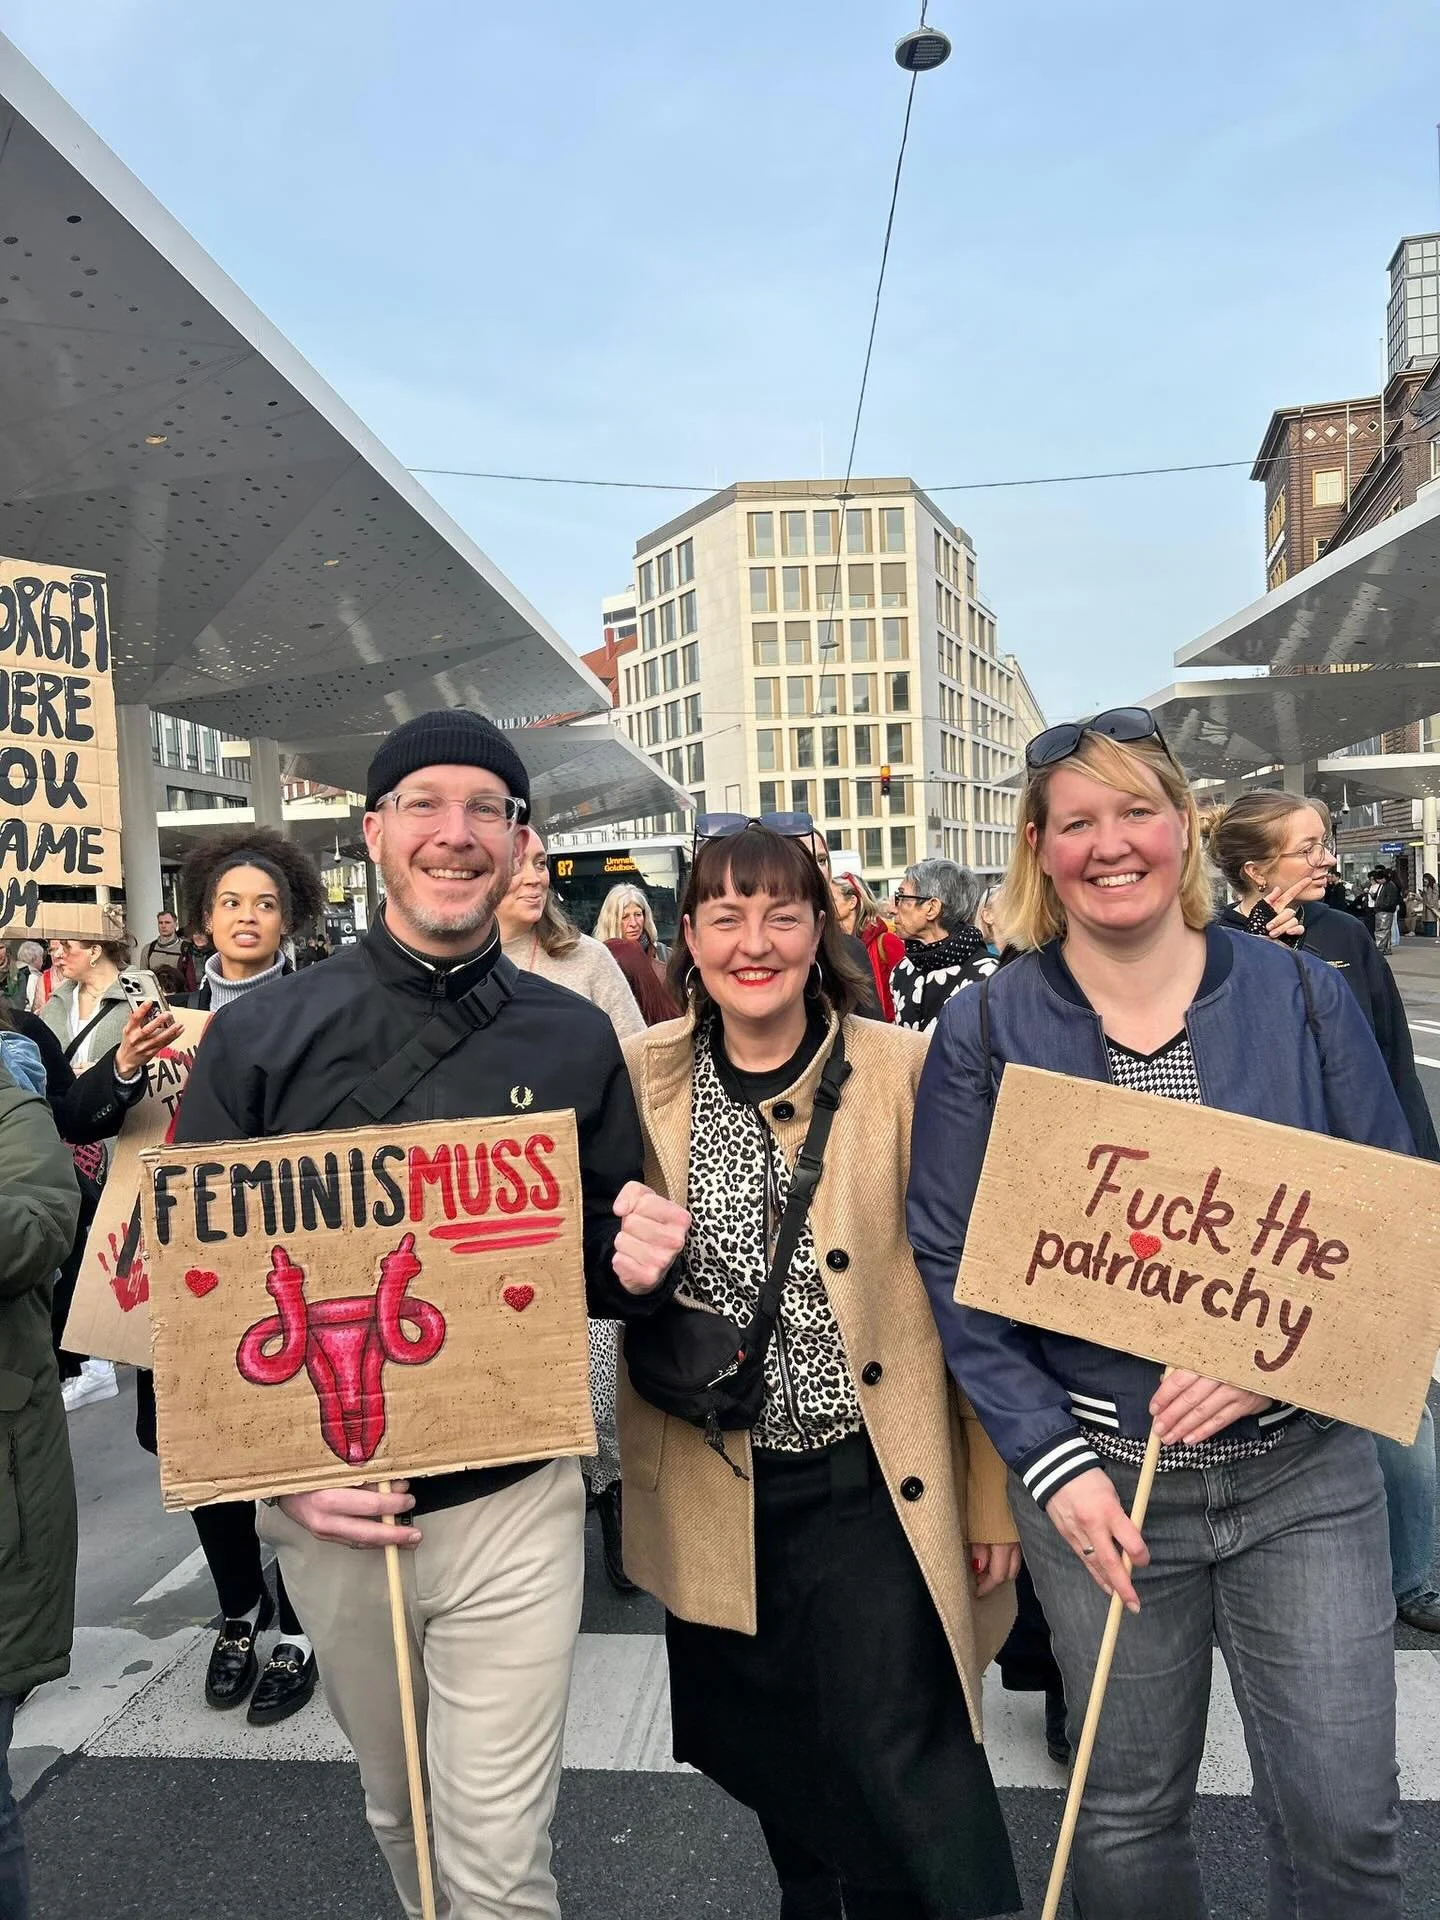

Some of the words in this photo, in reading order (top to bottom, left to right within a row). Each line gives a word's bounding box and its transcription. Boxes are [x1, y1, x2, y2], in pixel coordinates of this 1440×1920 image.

[558, 860, 573, 876] 87
[153, 1133, 560, 1246] FEMINISMUSS
[1087, 1144, 1235, 1255] Fuck
[1250, 1183, 1349, 1281] the
[1025, 1229, 1312, 1372] patriarchy
